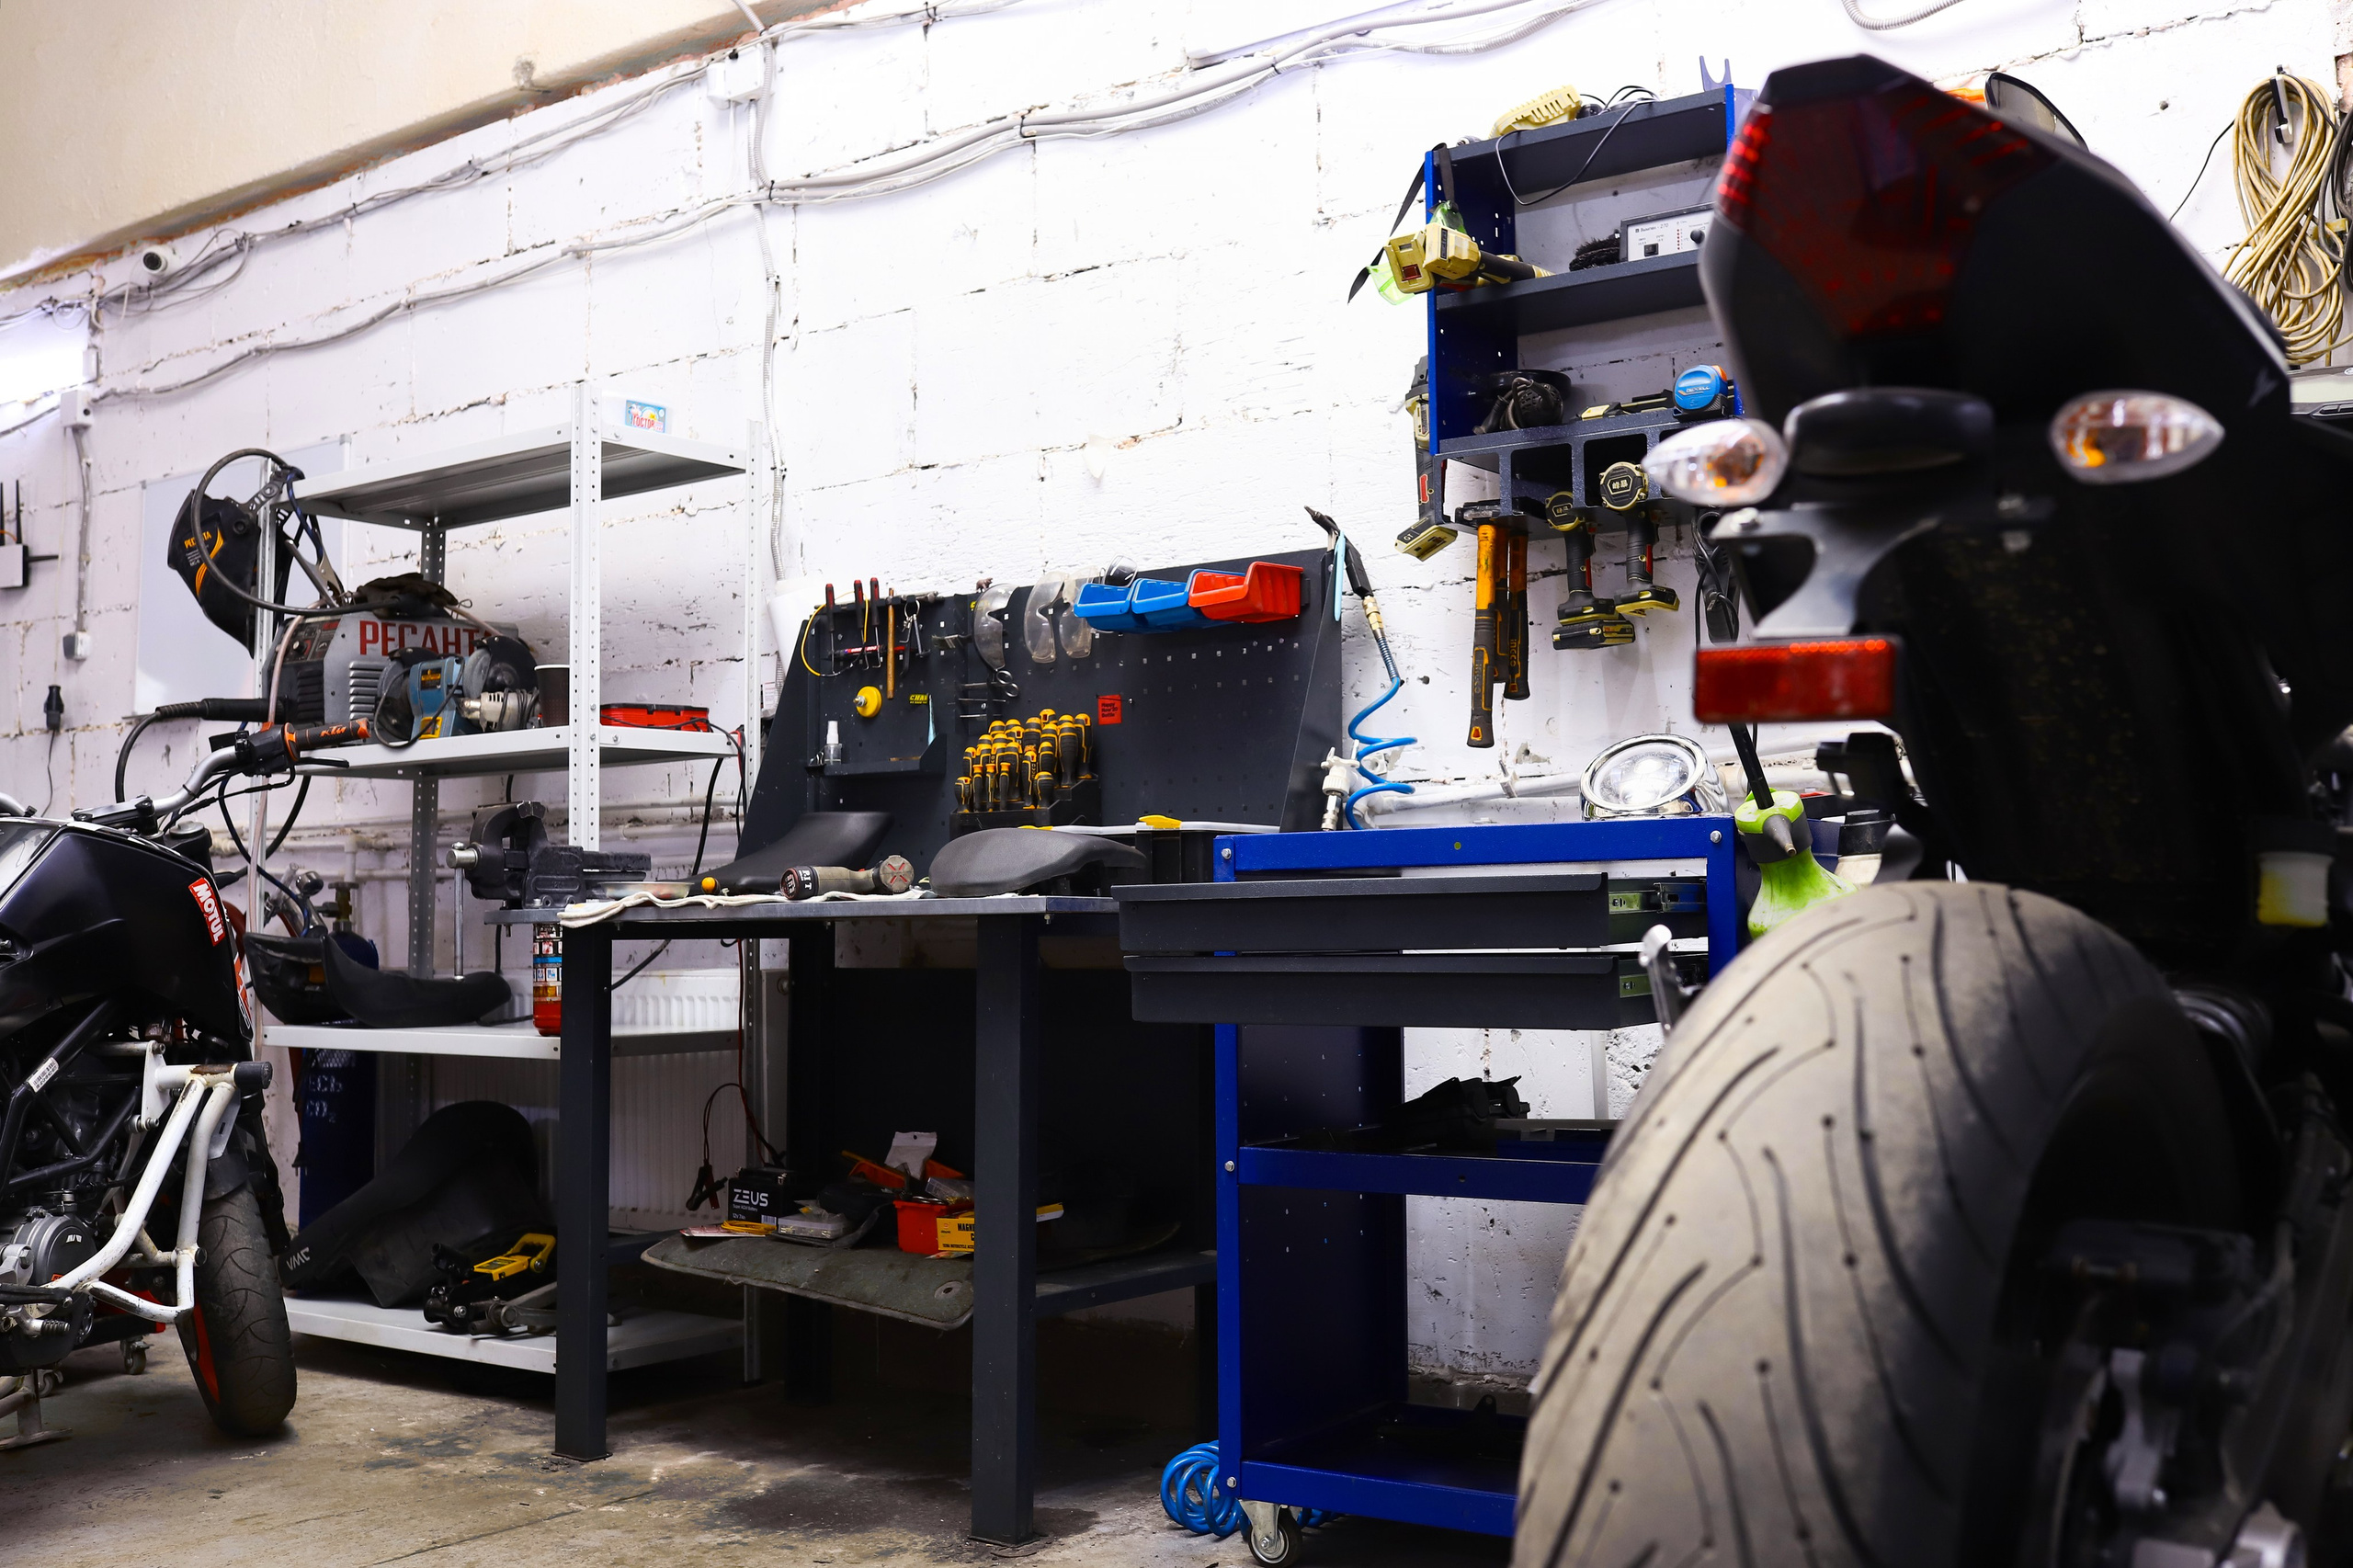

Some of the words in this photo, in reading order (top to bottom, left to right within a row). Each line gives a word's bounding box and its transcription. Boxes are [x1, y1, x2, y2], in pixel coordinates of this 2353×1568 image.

[185, 531, 211, 549] РЕСТА
[359, 619, 492, 656] РЕСАНТ
[193, 883, 223, 942] MOTUL
[733, 1188, 768, 1207] ZEUS
[286, 1246, 310, 1270] VMC
